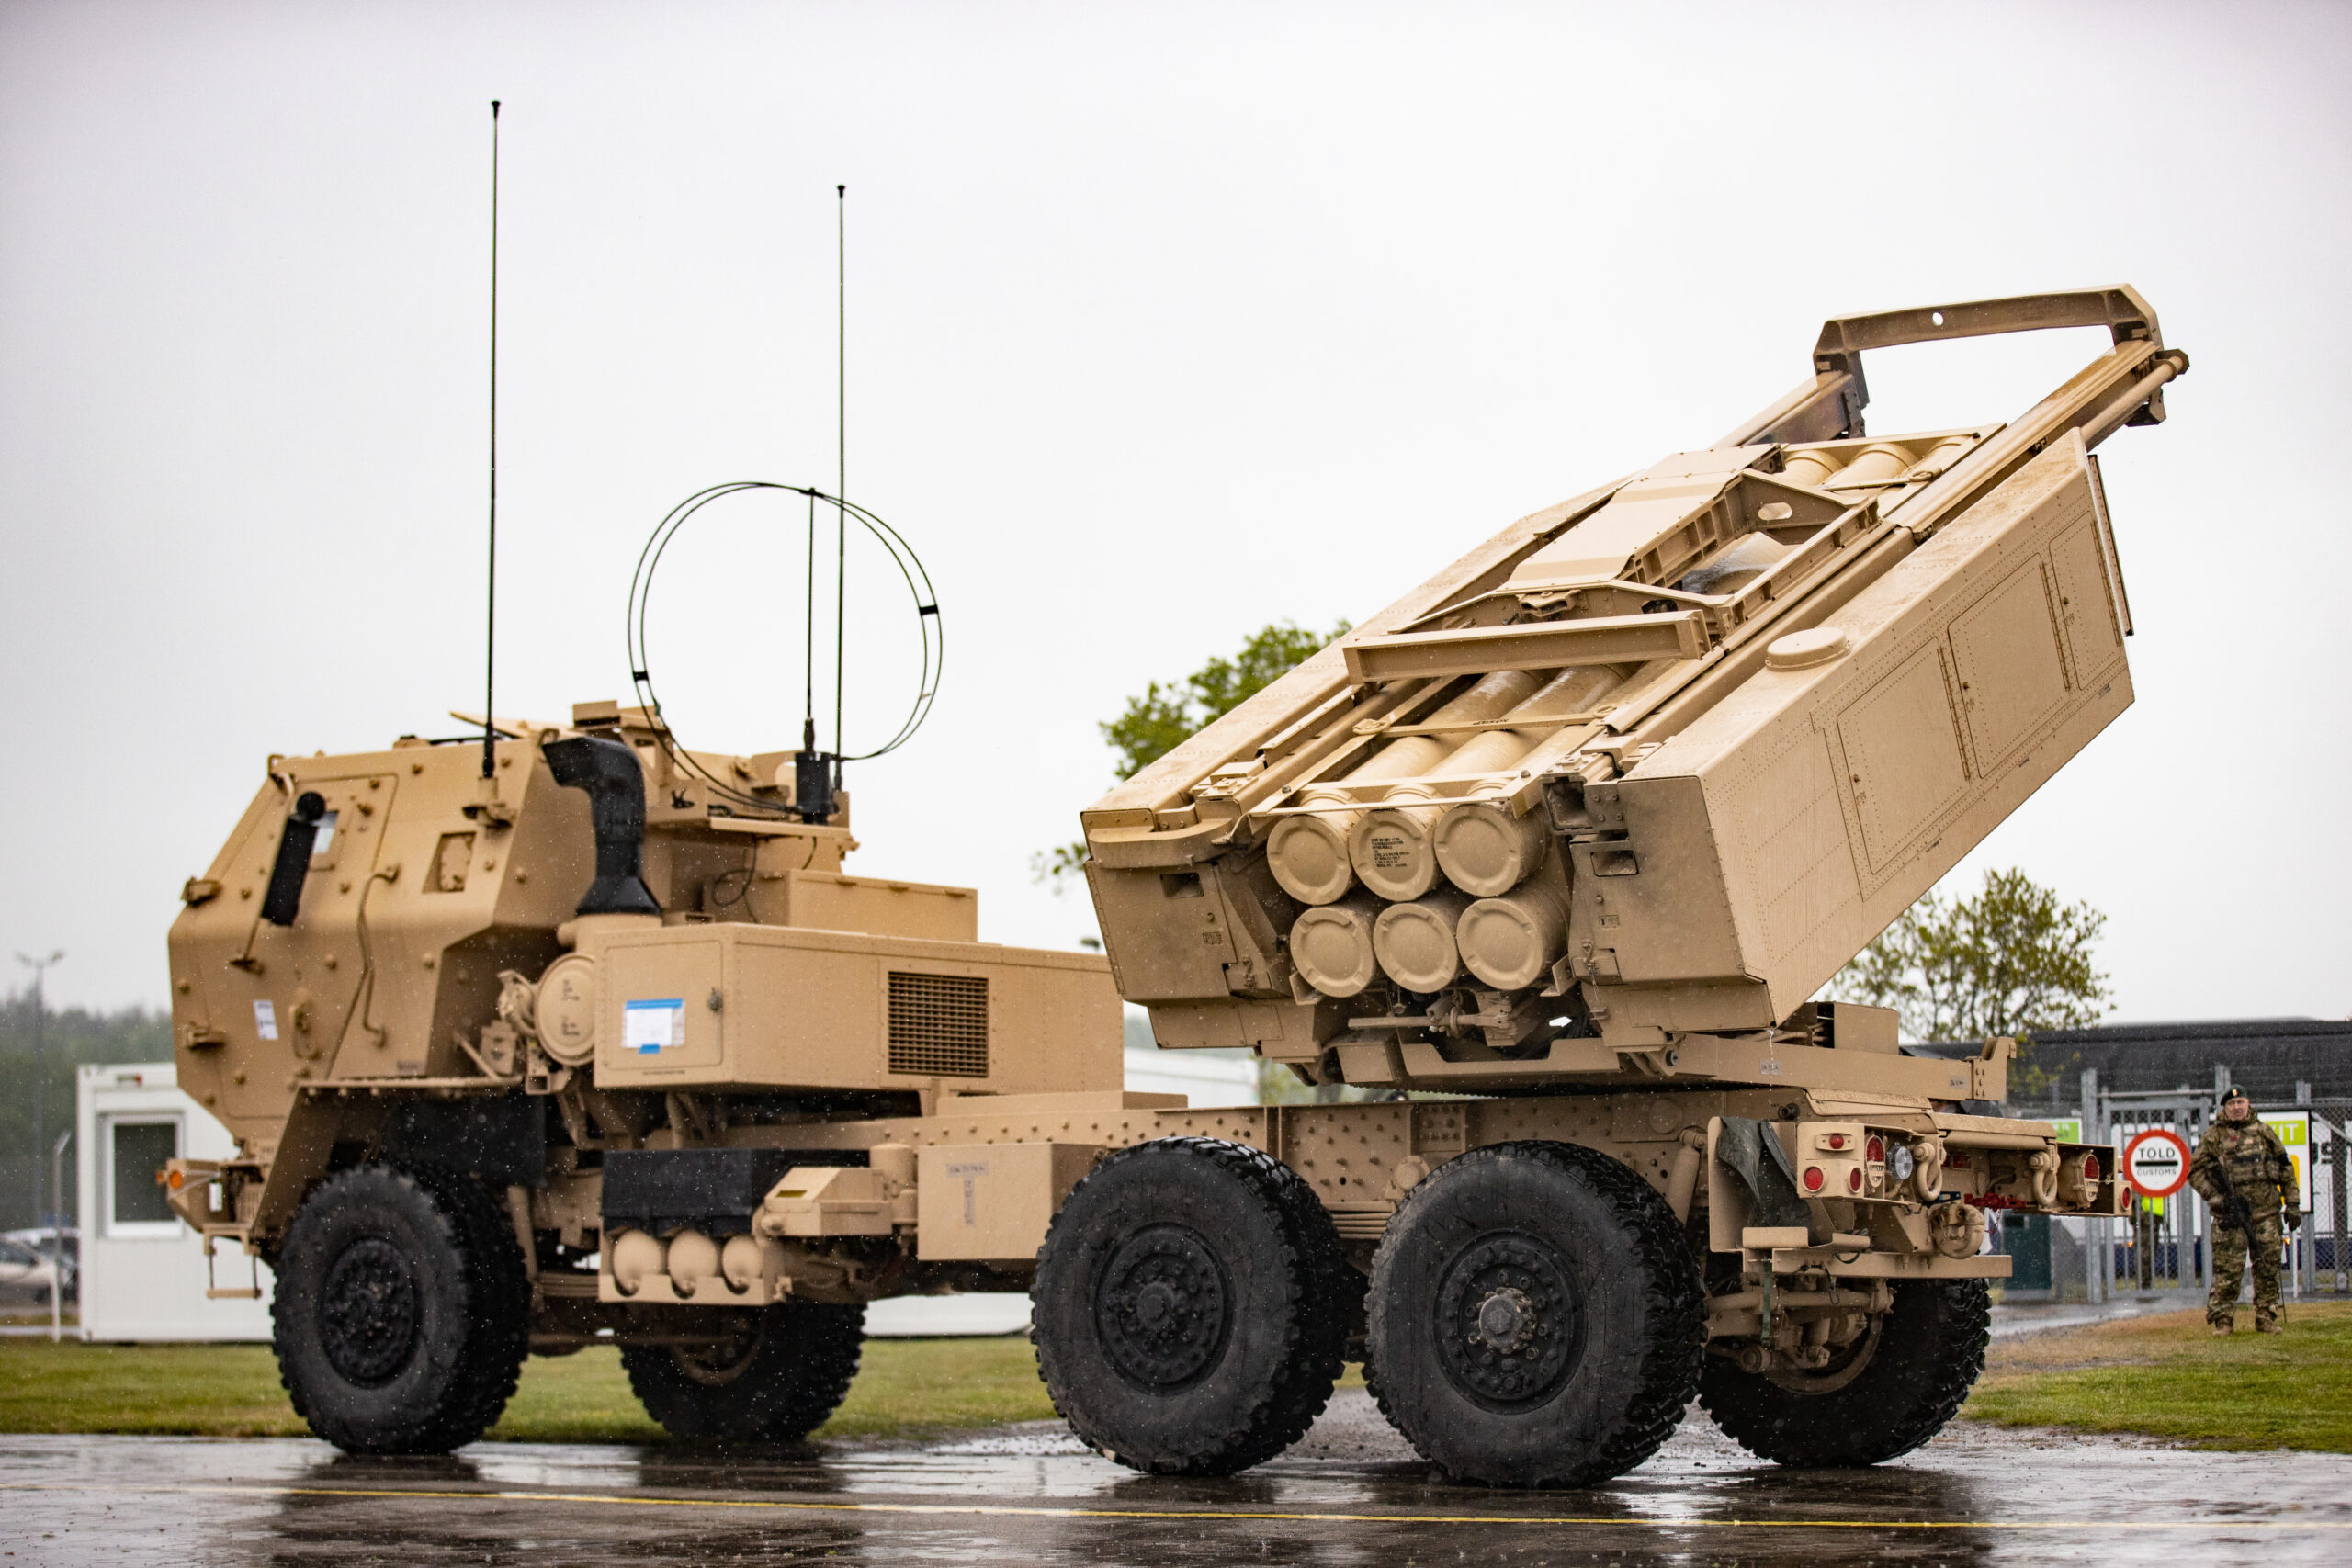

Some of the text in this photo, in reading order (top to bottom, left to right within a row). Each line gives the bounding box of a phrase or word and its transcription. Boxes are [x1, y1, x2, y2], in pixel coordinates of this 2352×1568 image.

[2272, 1123, 2299, 1141] IT
[2138, 1147, 2176, 1158] TOLD
[2137, 1168, 2177, 1176] CUSTOMS
